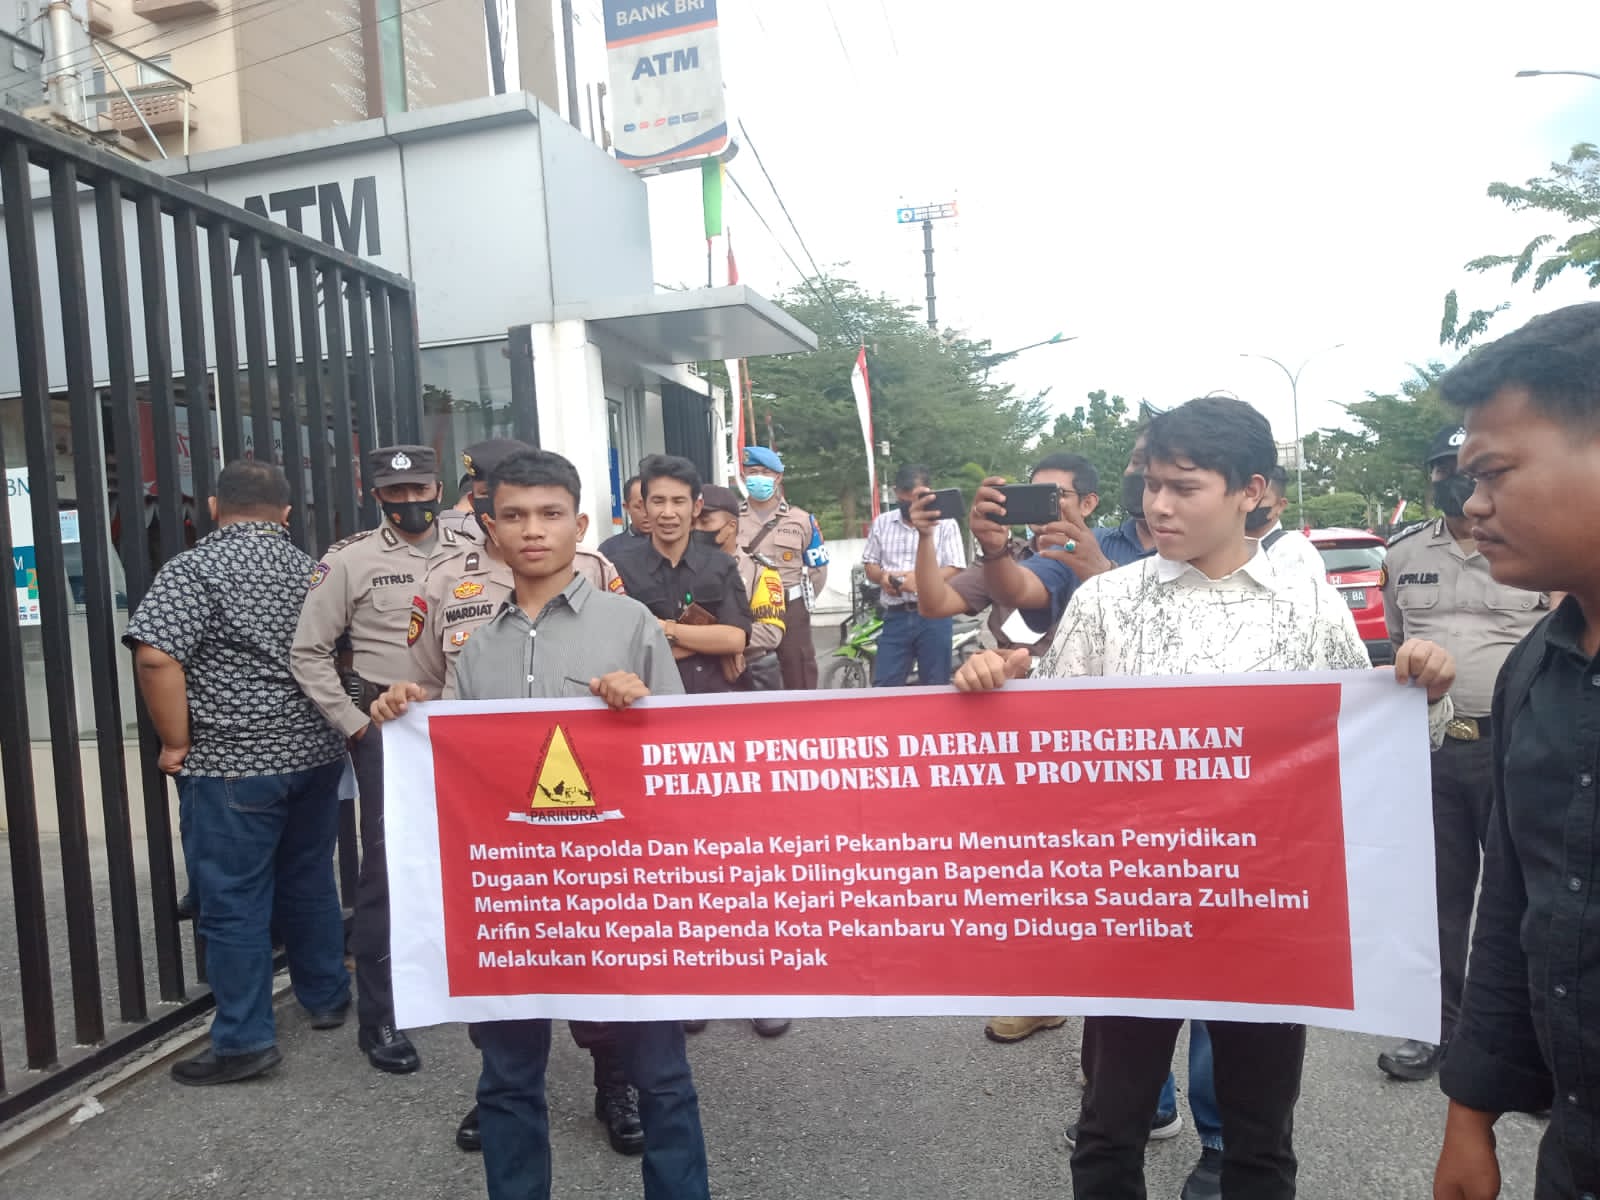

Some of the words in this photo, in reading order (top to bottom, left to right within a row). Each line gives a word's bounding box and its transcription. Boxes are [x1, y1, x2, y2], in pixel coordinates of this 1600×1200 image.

[616, 1, 670, 27] BANK
[631, 46, 699, 81] ATM
[372, 573, 415, 588] FITRUS
[445, 603, 494, 623] WARDIAT
[640, 740, 736, 767] DEWAN
[743, 735, 890, 764] PENGURUS
[896, 730, 1020, 758] DAERAH
[1028, 726, 1245, 753] PERGERAKAN
[643, 770, 763, 798] PELAJAR
[769, 765, 921, 793] INDONESIA
[927, 762, 1006, 788] RAYA
[1014, 758, 1164, 785] PROVINSI
[1174, 755, 1252, 781] RIAU
[530, 808, 599, 822] PARINDRA
[469, 841, 557, 861] Meminta
[560, 839, 643, 862] Kapolda
[647, 839, 689, 857] Dan
[692, 835, 765, 860] Kepala
[768, 833, 831, 859] Kejari
[834, 831, 953, 853] Pekanbaru
[959, 828, 1115, 850] Menuntaskan
[1120, 827, 1257, 852] Penyidikan
[471, 871, 549, 892] Dugaan
[552, 867, 629, 889] Korupsi
[632, 865, 725, 885] Retribusi
[728, 863, 788, 888] Pajak
[791, 862, 939, 887] Dilingkungan
[943, 859, 1044, 884] Bapenda
[1049, 859, 1103, 879] Kota
[1108, 858, 1240, 879] Pekanbaru
[474, 894, 562, 913] Meminta
[566, 892, 649, 916] Kapolda
[652, 892, 694, 910] Dan
[697, 890, 769, 914] Kepala
[773, 889, 835, 914] Kejari
[839, 888, 958, 909] Pekanbaru
[963, 887, 1089, 907] Memeriksa
[1094, 887, 1193, 907] Saudara
[1198, 887, 1309, 910] Zulhelmi
[476, 921, 531, 941] Arifin
[535, 920, 601, 939] Selaku
[605, 920, 673, 943] Kepala
[678, 919, 770, 943] Bapenda
[774, 919, 823, 938] Kota
[827, 917, 945, 938] Pekanbaru
[949, 917, 1008, 941] Yang
[1013, 917, 1097, 941] Diduga
[1100, 917, 1194, 938] Terlibat
[478, 949, 587, 969] Melakukan
[591, 948, 668, 971] Korupsi
[672, 947, 765, 967] Retribusi
[769, 947, 829, 971] Pajak
